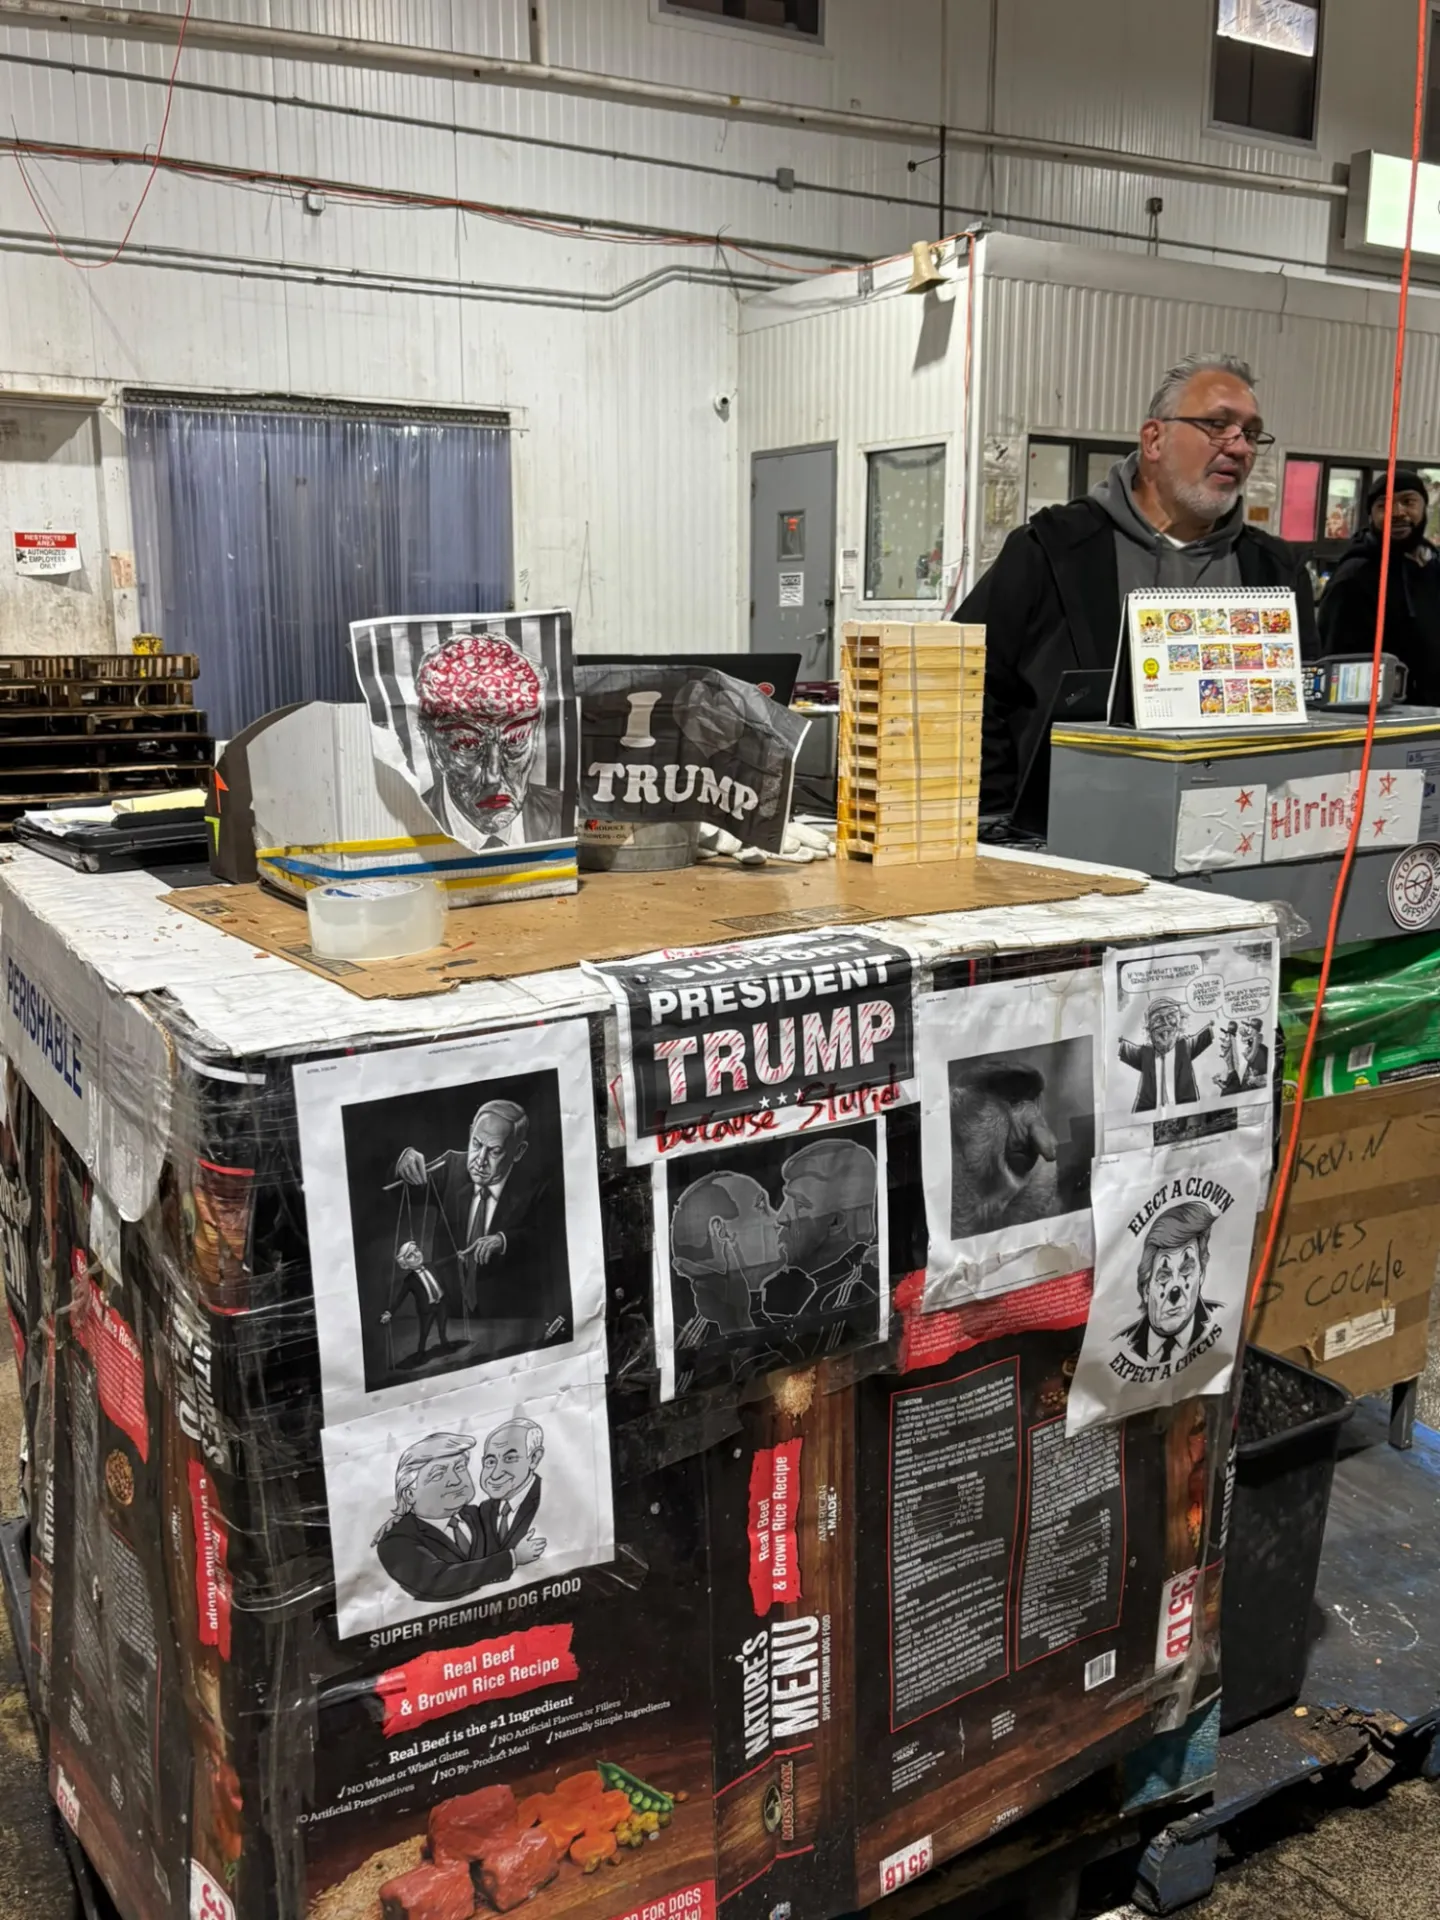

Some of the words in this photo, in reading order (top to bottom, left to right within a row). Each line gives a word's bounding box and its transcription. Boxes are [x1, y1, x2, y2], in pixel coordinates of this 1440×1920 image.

[24, 533, 67, 541] RESTRICTED
[620, 691, 662, 748] I
[588, 761, 759, 821] TRUMP
[1395, 854, 1417, 892] STOP
[1401, 884, 1440, 917] OFFSHORE
[660, 941, 871, 979] SUPPORT
[648, 953, 894, 1026] PRESIDENT
[7, 957, 83, 1100] PERISHABLE
[653, 999, 896, 1105] TRUMP
[797, 1063, 901, 1131] Stupid
[1127, 1184, 1169, 1237] ELECT
[1170, 1179, 1183, 1200] A
[1185, 1176, 1235, 1214] CLOWN
[1277, 1219, 1368, 1268] LOVES
[1109, 1351, 1159, 1383] EXPECT
[1159, 1365, 1173, 1381] A
[1175, 1323, 1223, 1373] CIRCUS
[772, 1456, 791, 1499] Recipe
[757, 1498, 770, 1529] Beef
[772, 1502, 787, 1531] Rice
[817, 1484, 828, 1542] AMERICAN
[828, 1493, 837, 1529] MADE
[757, 1530, 771, 1562] Real
[772, 1534, 787, 1577] Brown
[772, 1580, 787, 1591] &
[1168, 1570, 1198, 1616] 35
[369, 1621, 423, 1649] SUPER
[428, 1600, 502, 1634] PREMIUM
[507, 1590, 538, 1612] DOG
[542, 1577, 582, 1601] FOOD
[822, 1614, 831, 1637] FOOD
[822, 1638, 831, 1654] DOG
[1166, 1615, 1193, 1659] LB
[443, 1656, 478, 1681] Real
[482, 1644, 517, 1669] Beef
[771, 1615, 820, 1739] MENU
[822, 1654, 831, 1694] PREMIUM
[400, 1698, 413, 1717] &
[418, 1684, 468, 1712] Brown
[472, 1671, 505, 1695] Rice
[509, 1656, 560, 1684] Recipe
[738, 1630, 770, 1761] NATURE'S
[822, 1693, 831, 1722] SUPER
[388, 1743, 419, 1765] Real
[421, 1733, 450, 1753] Beef
[452, 1730, 465, 1742] is
[466, 1723, 488, 1739] the
[489, 1714, 507, 1730] #1
[508, 1695, 575, 1725] Ingredient
[498, 1731, 514, 1745] NO
[514, 1717, 551, 1739] Artificial
[552, 1709, 584, 1727] Flavors
[584, 1707, 595, 1717] or
[595, 1699, 622, 1713] Fillers
[554, 1719, 594, 1742] Naturally
[594, 1712, 624, 1730] Simple
[624, 1699, 671, 1721] Ingredients
[346, 1783, 365, 1796] NO
[364, 1773, 396, 1791] Wheat
[396, 1769, 407, 1779] or
[407, 1757, 438, 1775] Wheat
[438, 1747, 470, 1764] Gluten
[439, 1766, 456, 1781] NO
[457, 1749, 508, 1776] By-Product
[508, 1741, 531, 1759] Meal
[781, 1760, 794, 1793] OAK
[309, 1802, 353, 1823] Artificial
[353, 1782, 416, 1810] Preservatives
[781, 1793, 794, 1841] MOSSY
[885, 1861, 905, 1892] LB
[908, 1849, 929, 1880] 35
[642, 1901, 666, 1920] FOR
[669, 1887, 702, 1914] DOGS
